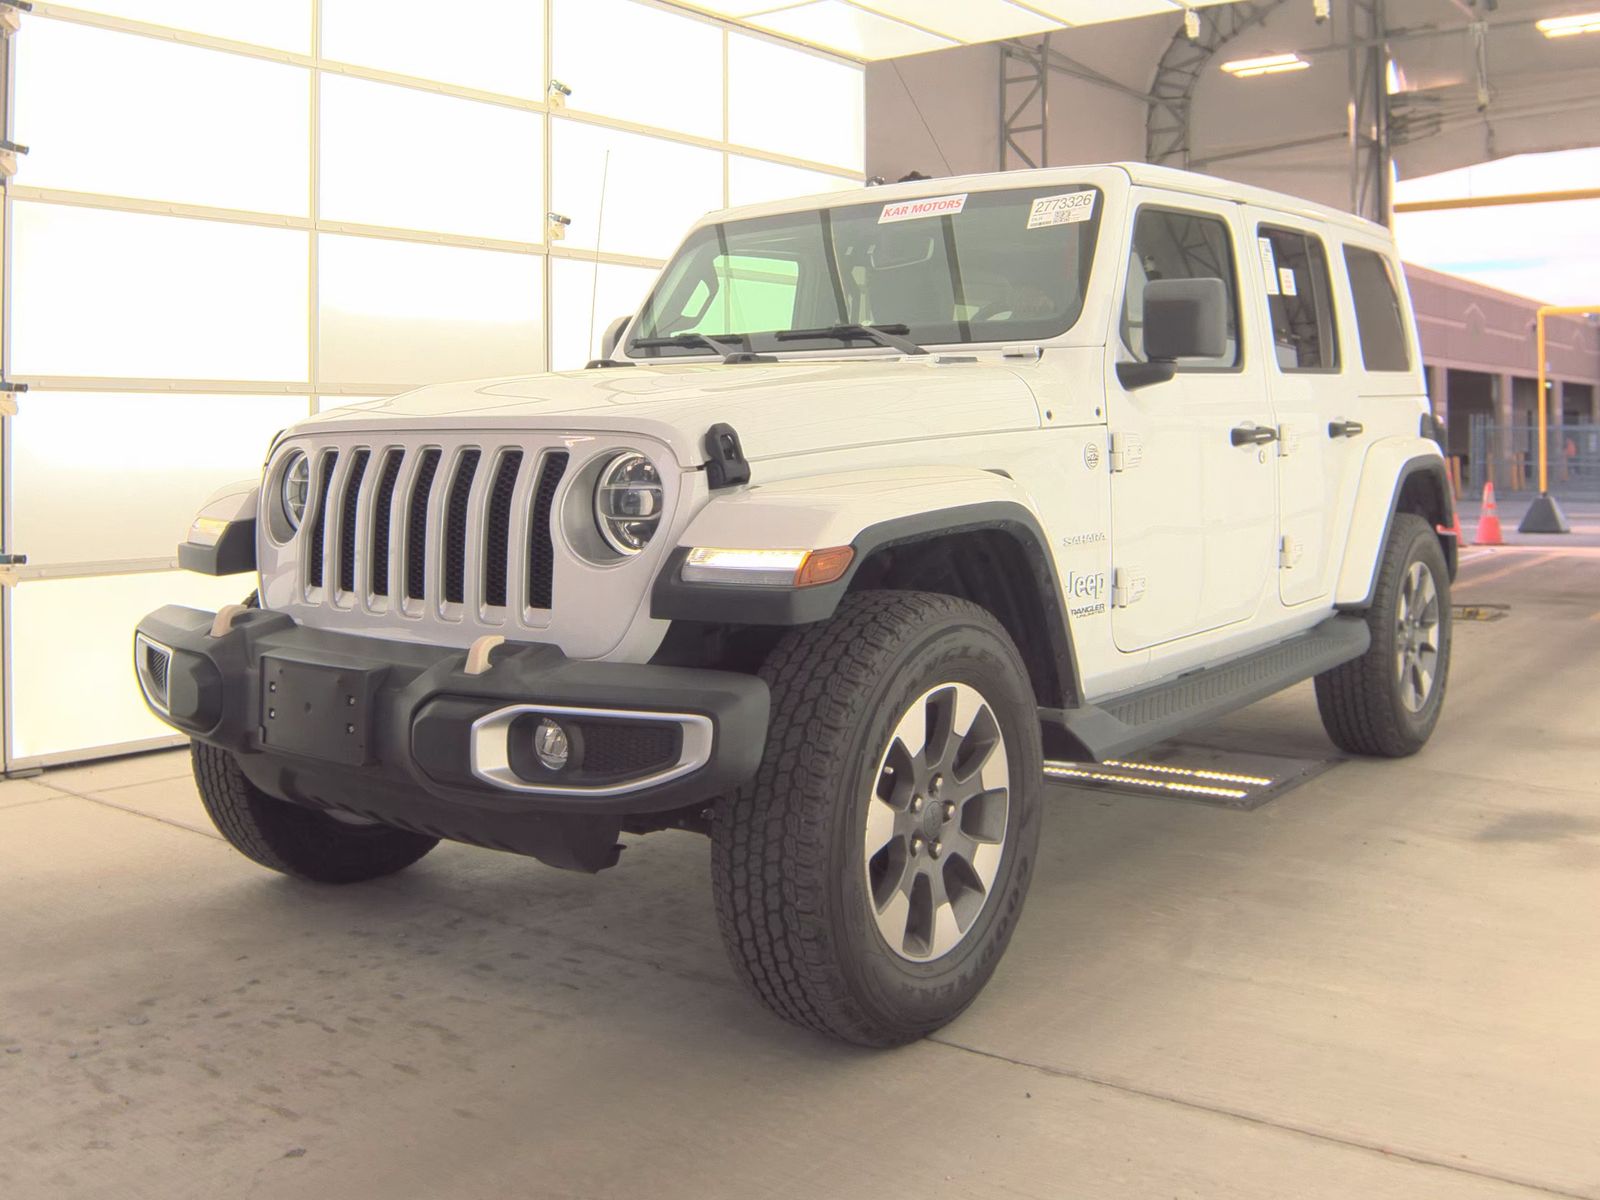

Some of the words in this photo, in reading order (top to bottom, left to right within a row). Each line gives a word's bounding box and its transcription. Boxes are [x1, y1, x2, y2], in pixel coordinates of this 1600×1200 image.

[883, 207, 909, 218] KAR
[911, 199, 962, 214] MOTORS
[1035, 194, 1092, 213] 2773326
[1063, 532, 1106, 546] SAHARA
[1067, 570, 1105, 600] Jeep
[1070, 603, 1105, 615] RANGLER
